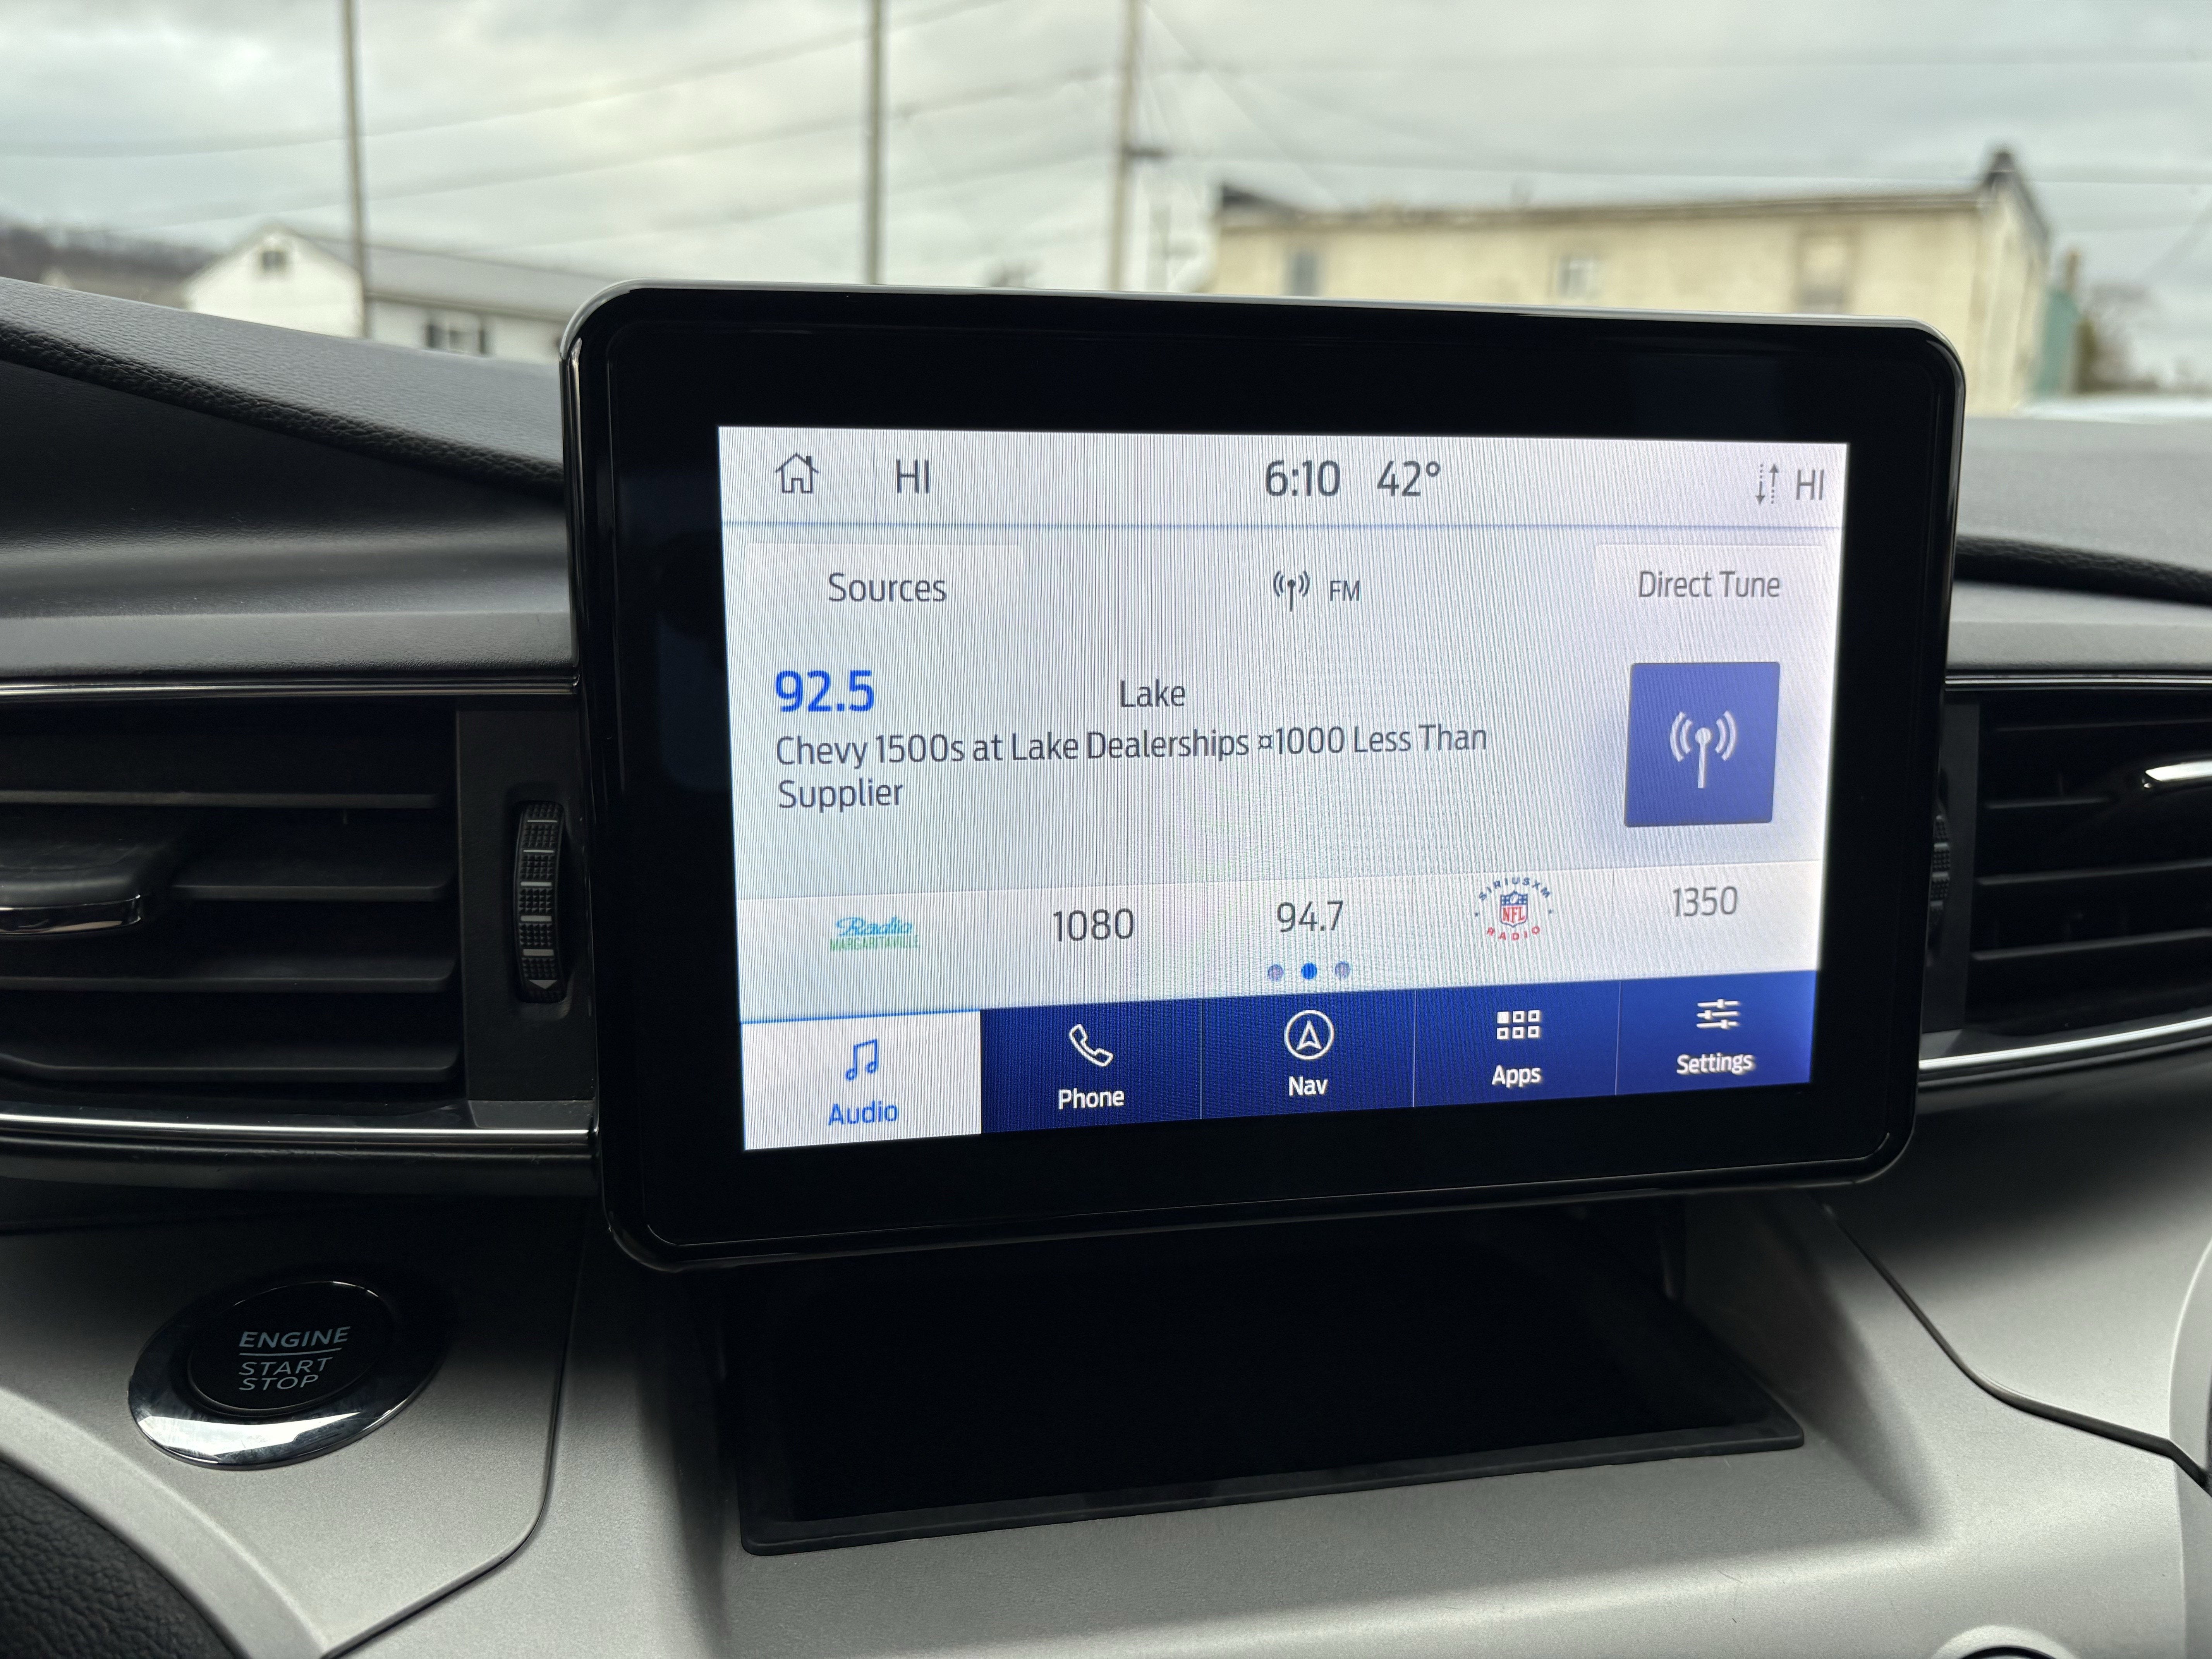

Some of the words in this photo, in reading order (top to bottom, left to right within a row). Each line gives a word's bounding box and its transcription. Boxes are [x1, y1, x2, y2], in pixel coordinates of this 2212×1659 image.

[895, 459, 931, 494] HI
[1264, 460, 1341, 498] 6:10
[1795, 469, 1824, 501] HI
[828, 572, 948, 603] Sources
[1329, 580, 1361, 602] FM
[1638, 570, 1712, 598] Direct
[1719, 571, 1781, 598] Tune
[775, 670, 875, 713] 92.5
[1120, 680, 1187, 708] Lake
[776, 735, 868, 770] Chevy
[875, 734, 965, 764] 1500s
[972, 734, 1003, 762] at
[1012, 732, 1080, 761] Lake
[1087, 730, 1249, 761] Dealerships
[1353, 726, 1412, 753] Less
[1418, 723, 1488, 751] Than
[778, 778, 903, 813] Supplier
[1477, 876, 1551, 901] SIRIUSXM
[1673, 886, 1738, 917] 1350
[835, 916, 913, 936] Radio
[1053, 908, 1135, 943] 1080
[1276, 900, 1345, 933] 94.7
[1502, 905, 1526, 924] NFL
[830, 935, 920, 951] MARGARITAVILLE
[1486, 925, 1541, 941] RADIO
[1492, 1064, 1542, 1088] Apps
[1676, 1052, 1754, 1077] Settings
[1058, 1087, 1125, 1111] Phone
[1288, 1076, 1328, 1097] Nav
[828, 1102, 899, 1126] Audio
[239, 1326, 351, 1348] ENGINE
[239, 1357, 333, 1376] START
[239, 1374, 319, 1390] STOP
